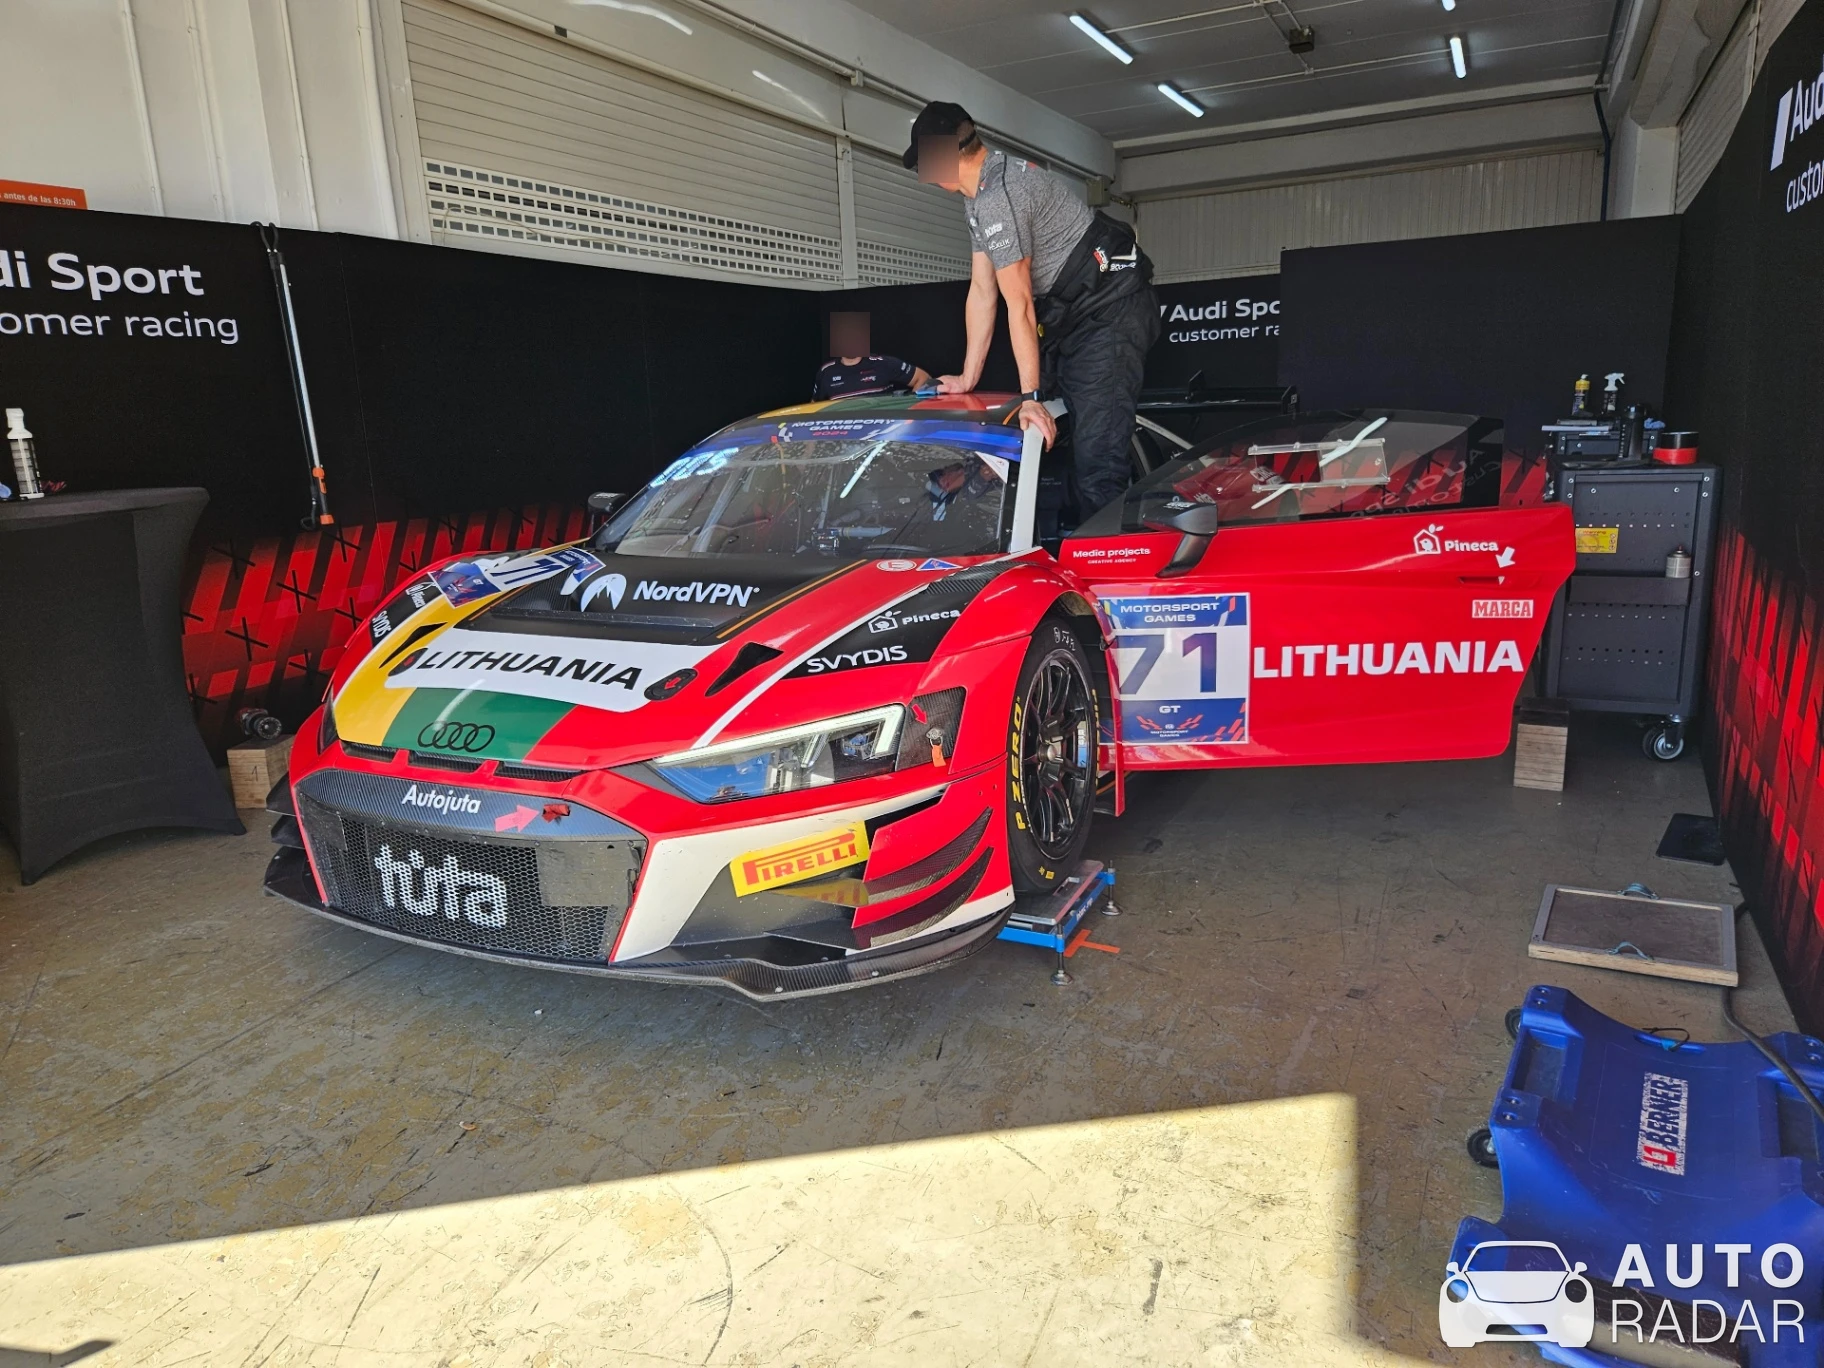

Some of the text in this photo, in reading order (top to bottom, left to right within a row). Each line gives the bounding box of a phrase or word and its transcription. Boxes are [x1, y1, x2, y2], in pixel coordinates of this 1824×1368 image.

[3, 192, 76, 206] antes de las 8:30h
[1786, 160, 1824, 213] custo
[48, 252, 205, 300] Sport
[1168, 300, 1228, 322] Audi
[0, 311, 239, 345] omer racing
[1168, 326, 1260, 343] customer
[791, 418, 896, 429] MOTORSPORT
[1072, 547, 1152, 558] Media projects
[1444, 539, 1499, 553] Pineca
[902, 608, 962, 625] Pineca
[1120, 602, 1221, 614] MOTORSPORT
[1144, 614, 1197, 623] GAMES
[1473, 600, 1533, 618] MARCA
[416, 651, 643, 691] LITHUANIA
[807, 645, 908, 674] SVYDIS
[1116, 632, 1217, 695] 71
[1253, 640, 1524, 679] LITHUANIA
[1159, 705, 1182, 714] GT
[1011, 702, 1026, 831] P ZERO
[401, 784, 482, 815] Autojuta
[742, 832, 858, 886] PIRELLI
[1646, 1079, 1683, 1149] BERNER
